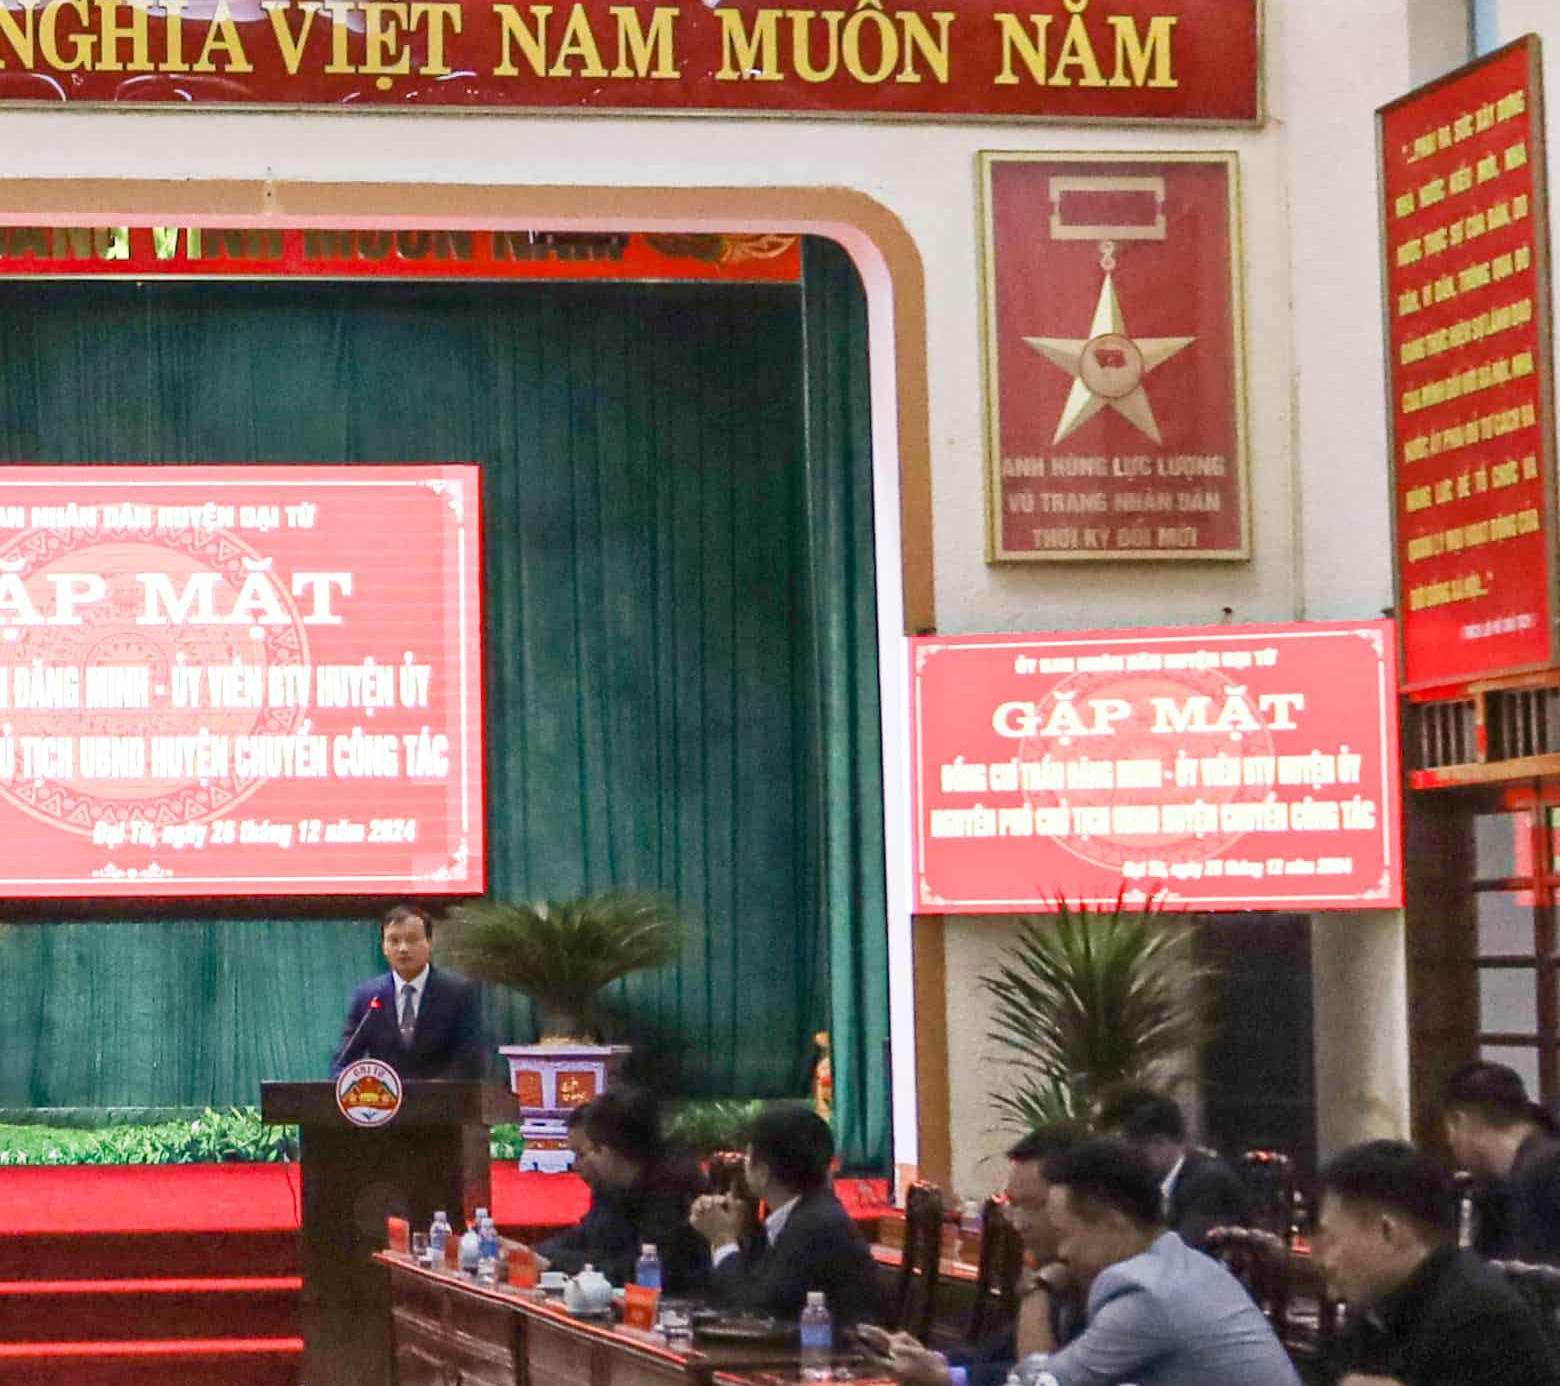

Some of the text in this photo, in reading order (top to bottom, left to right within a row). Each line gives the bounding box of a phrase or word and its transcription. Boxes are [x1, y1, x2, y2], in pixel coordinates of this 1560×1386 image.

[492, 3, 680, 79] NAM
[31, 502, 97, 528] NHÂN
[104, 502, 151, 528] DÂN
[158, 502, 233, 532] HUYỆN
[240, 505, 279, 532] ĐẠI
[135, 556, 352, 641] MẶT
[14, 656, 80, 709] ĐĂNG
[86, 666, 149, 709] MINH
[171, 652, 202, 708] ỦY
[207, 656, 262, 708] VIÊN
[268, 665, 311, 708] BTV
[317, 656, 395, 717] HUYỆN
[399, 651, 431, 708] ỦY
[992, 684, 1304, 746] GẶP MẶT
[20, 736, 73, 788] TỊCH
[79, 735, 145, 778] UBND
[151, 726, 228, 787] HUYỆN
[235, 718, 328, 777] CHUYỂN
[333, 726, 399, 777] CÔNG
[403, 725, 449, 777] TÁC
[93, 820, 125, 848] Đại
[161, 821, 207, 848] ngày
[240, 819, 293, 848] tháng
[299, 820, 321, 843] 12
[368, 819, 416, 843] 2024
